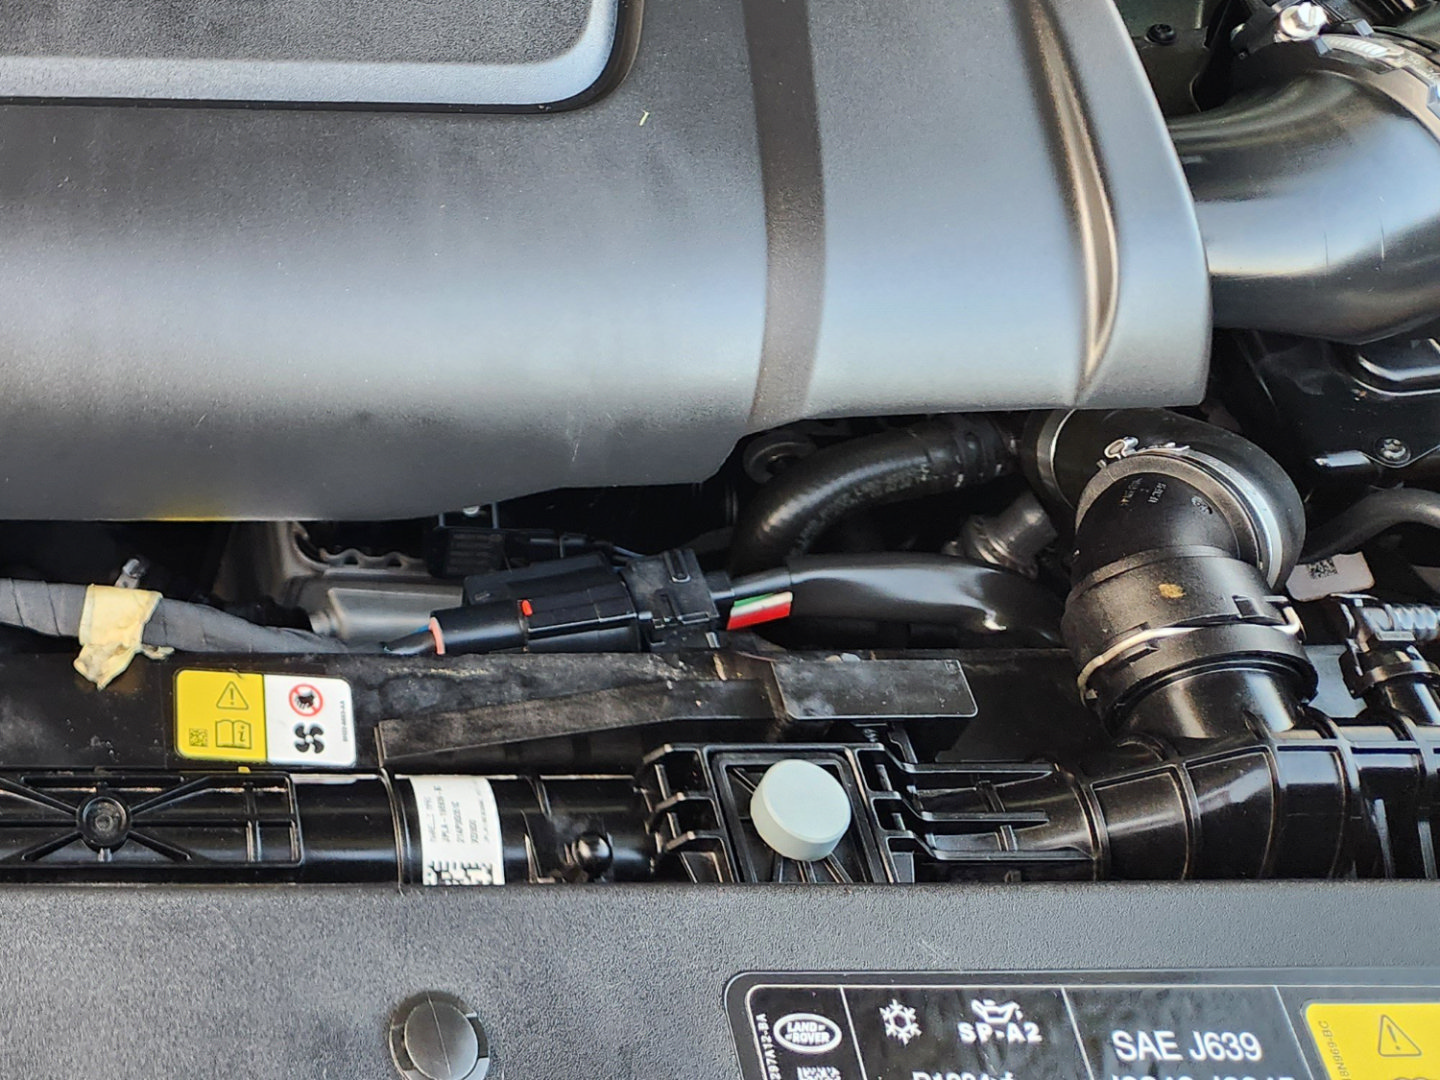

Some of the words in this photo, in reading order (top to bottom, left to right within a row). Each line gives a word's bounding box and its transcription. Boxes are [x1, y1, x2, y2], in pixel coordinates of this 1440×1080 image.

[786, 1021, 818, 1033] LAND
[957, 1021, 1043, 1043] SP-A2
[792, 1031, 831, 1045] ROVER
[1111, 1029, 1184, 1062] SAE
[1188, 1030, 1264, 1062] J639
